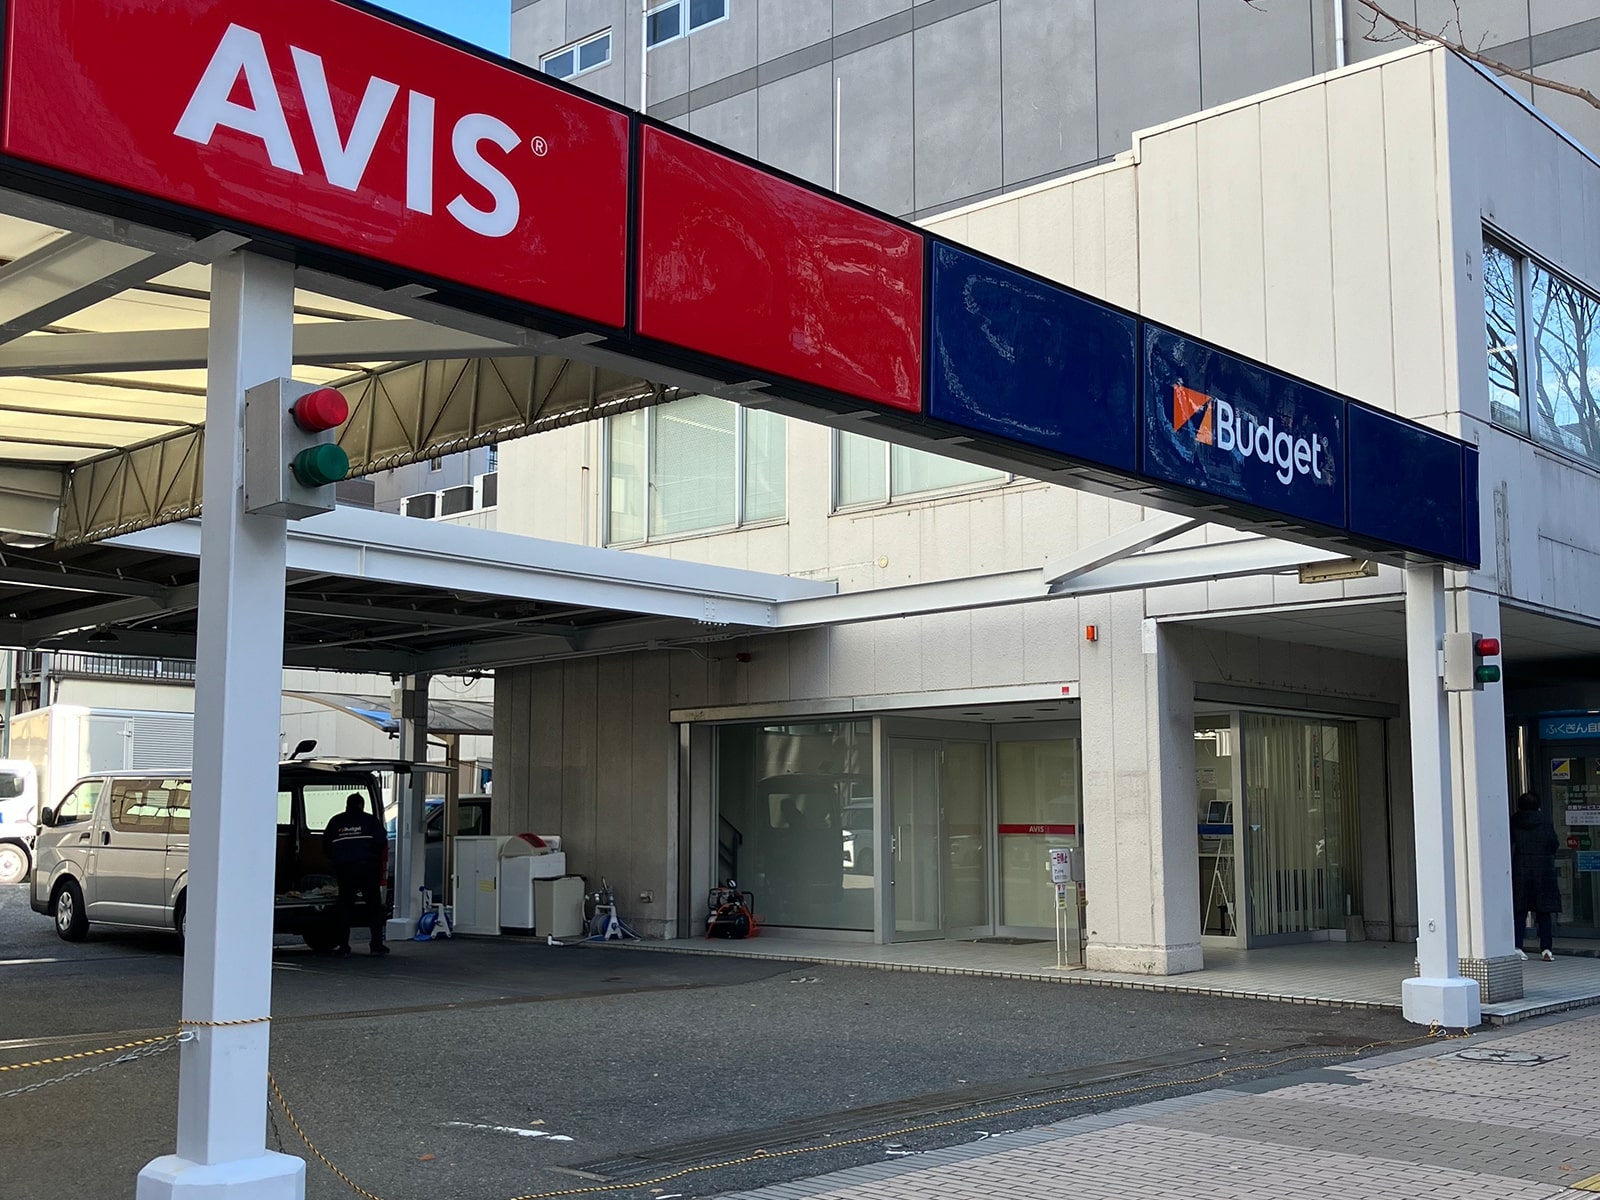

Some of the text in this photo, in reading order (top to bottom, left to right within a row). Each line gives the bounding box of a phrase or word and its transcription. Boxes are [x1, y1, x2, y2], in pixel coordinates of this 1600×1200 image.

[173, 22, 522, 238] AVIS
[1216, 399, 1322, 485] Budget
[1545, 723, 1600, 735] ふくぎん自
